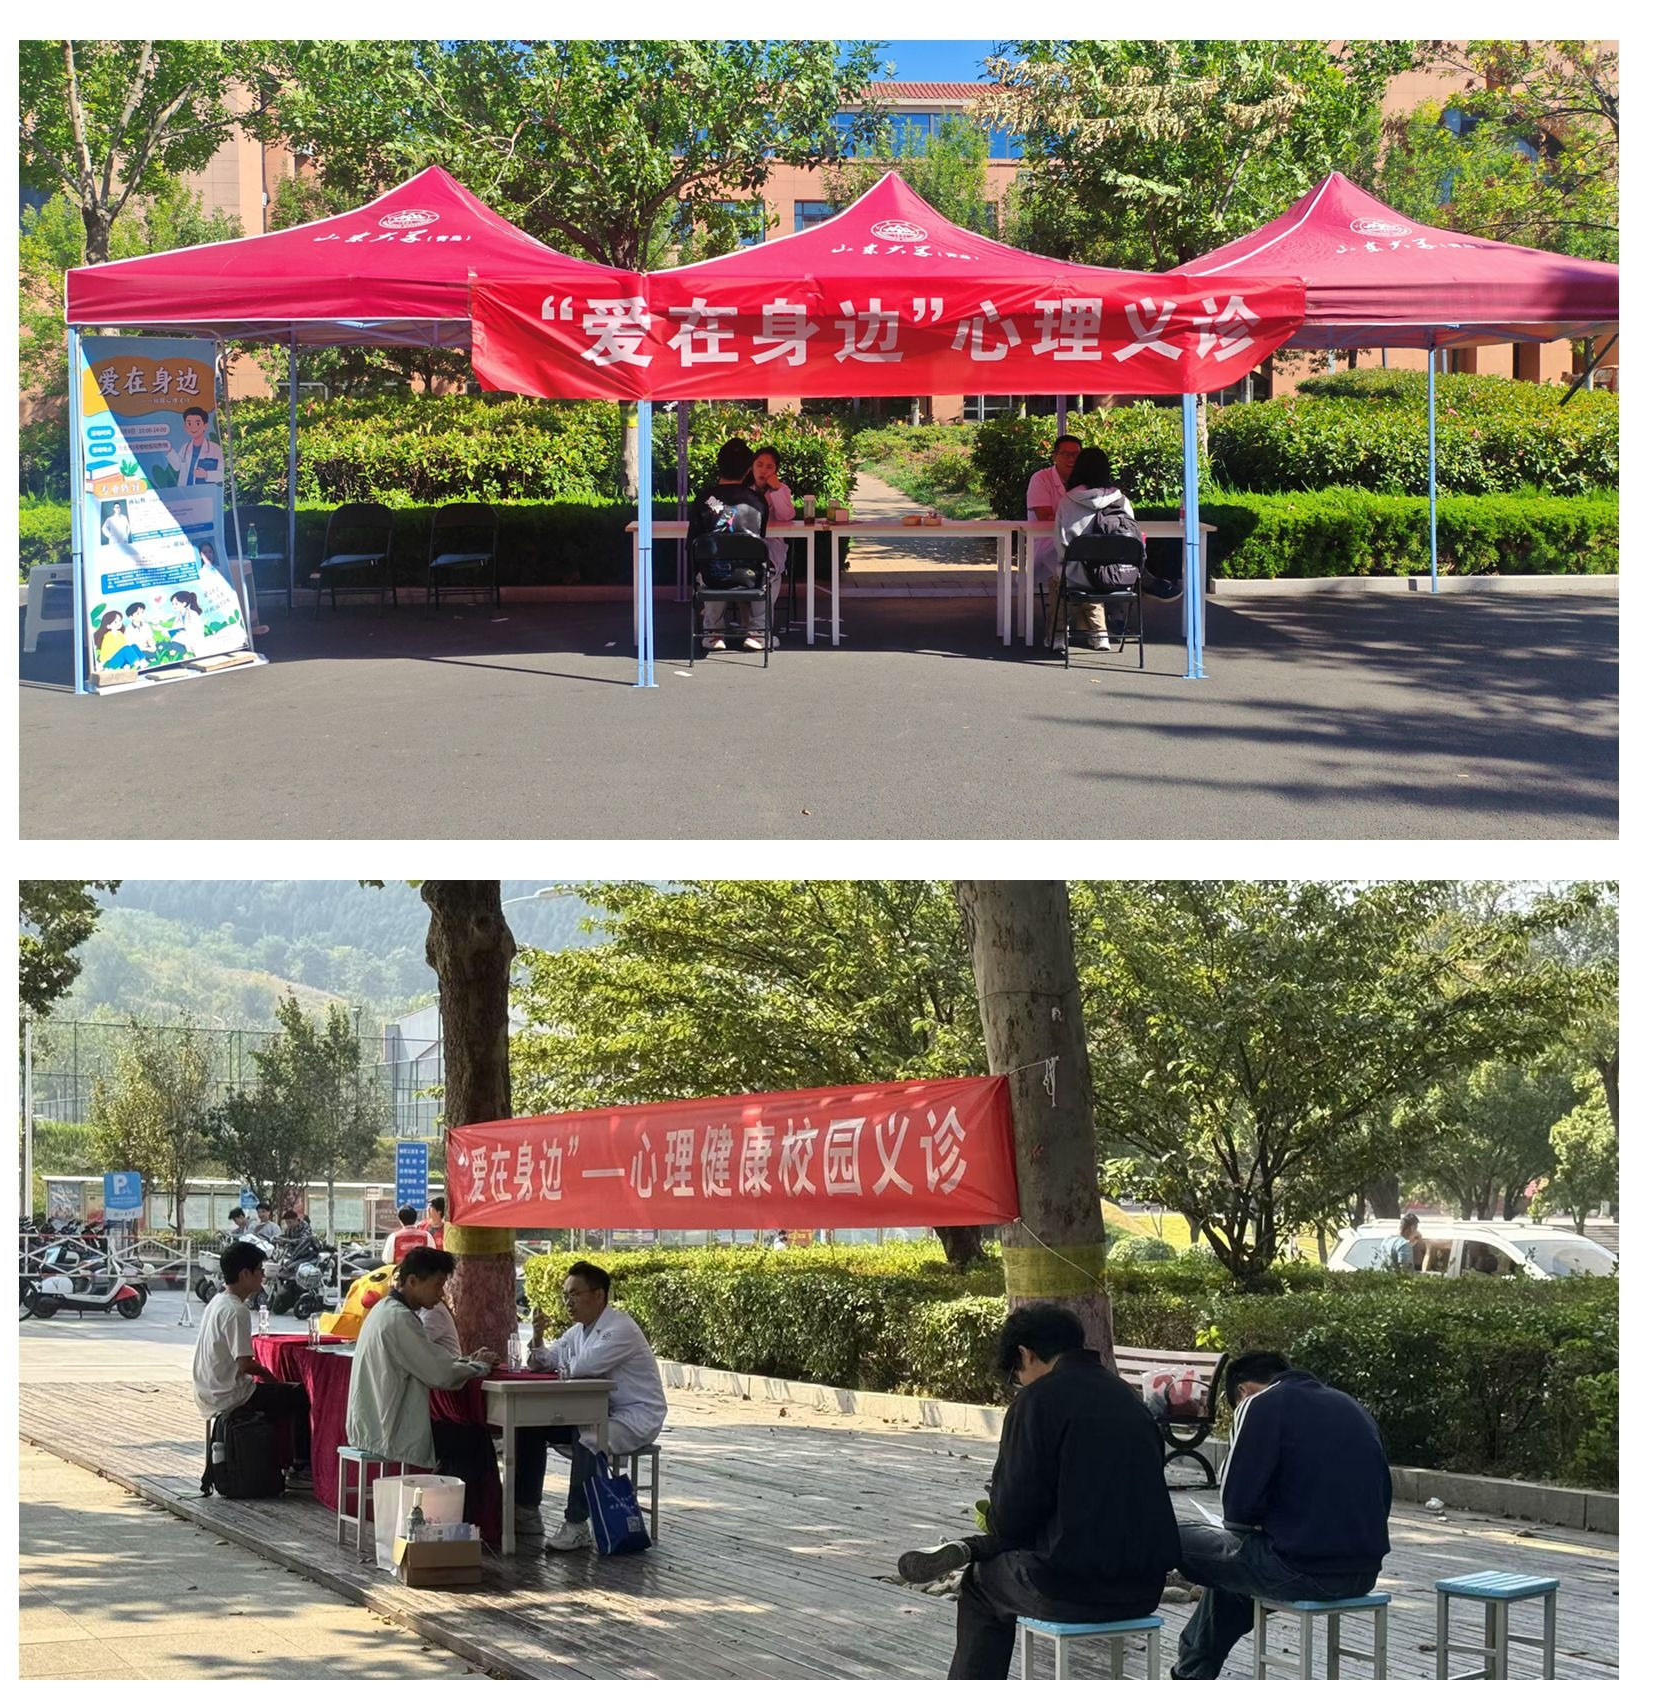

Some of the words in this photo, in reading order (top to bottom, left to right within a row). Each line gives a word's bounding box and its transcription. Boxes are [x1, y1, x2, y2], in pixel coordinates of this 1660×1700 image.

[541, 295, 1261, 367] “爱在身边”心理义诊
[98, 366, 200, 396] 爱在身边
[113, 1175, 127, 1195] P
